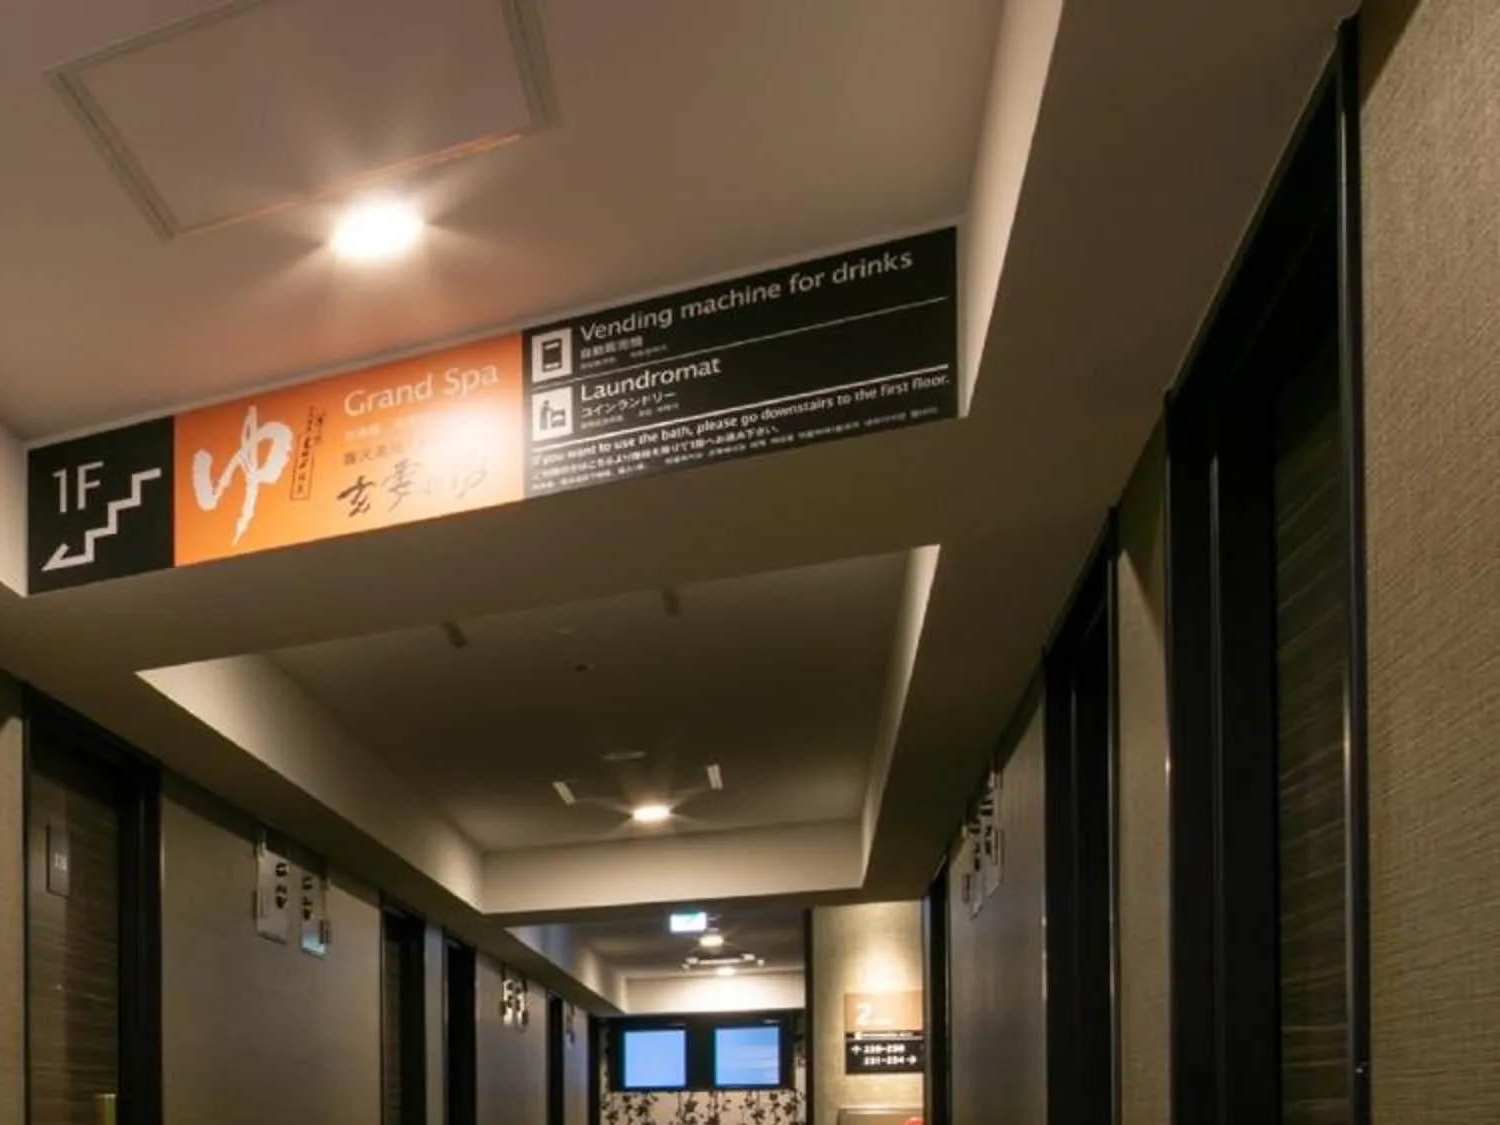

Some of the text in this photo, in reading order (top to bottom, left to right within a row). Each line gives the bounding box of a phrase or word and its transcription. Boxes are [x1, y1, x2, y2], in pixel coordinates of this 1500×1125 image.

[580, 251, 914, 342] Vending machine for drinks
[344, 364, 500, 416] Grand Spa
[581, 358, 721, 401] Laundromat
[567, 445, 597, 460] want
[599, 442, 611, 453] to
[614, 438, 636, 451] use
[639, 431, 659, 446] the
[697, 416, 738, 436] please
[741, 413, 758, 427] go
[761, 399, 834, 421] downstairs
[837, 394, 851, 406] to
[855, 386, 877, 401] the
[880, 382, 909, 397] first
[912, 373, 949, 391] floor.
[52, 461, 105, 514] 1F
[191, 404, 294, 547] ゆ
